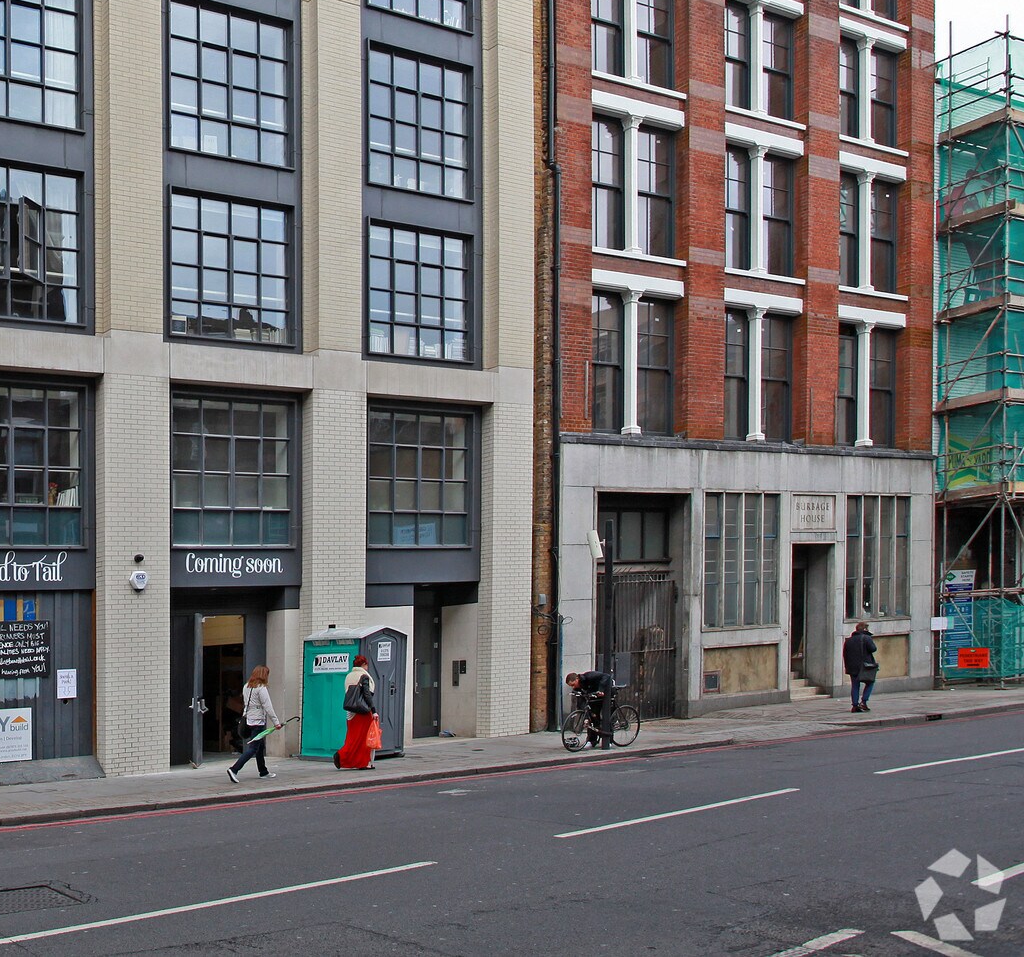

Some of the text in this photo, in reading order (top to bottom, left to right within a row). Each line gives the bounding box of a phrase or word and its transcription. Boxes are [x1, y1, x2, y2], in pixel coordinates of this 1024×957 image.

[796, 502, 829, 511] BURBAGE
[801, 514, 825, 523] HOUSE
[11, 561, 30, 582] to
[31, 551, 67, 582] Tail
[186, 552, 284, 578] Coming soon
[9, 623, 34, 632] NEEDS
[26, 632, 45, 640] MUST
[322, 655, 348, 664] DAVLAV
[10, 723, 29, 732] build
